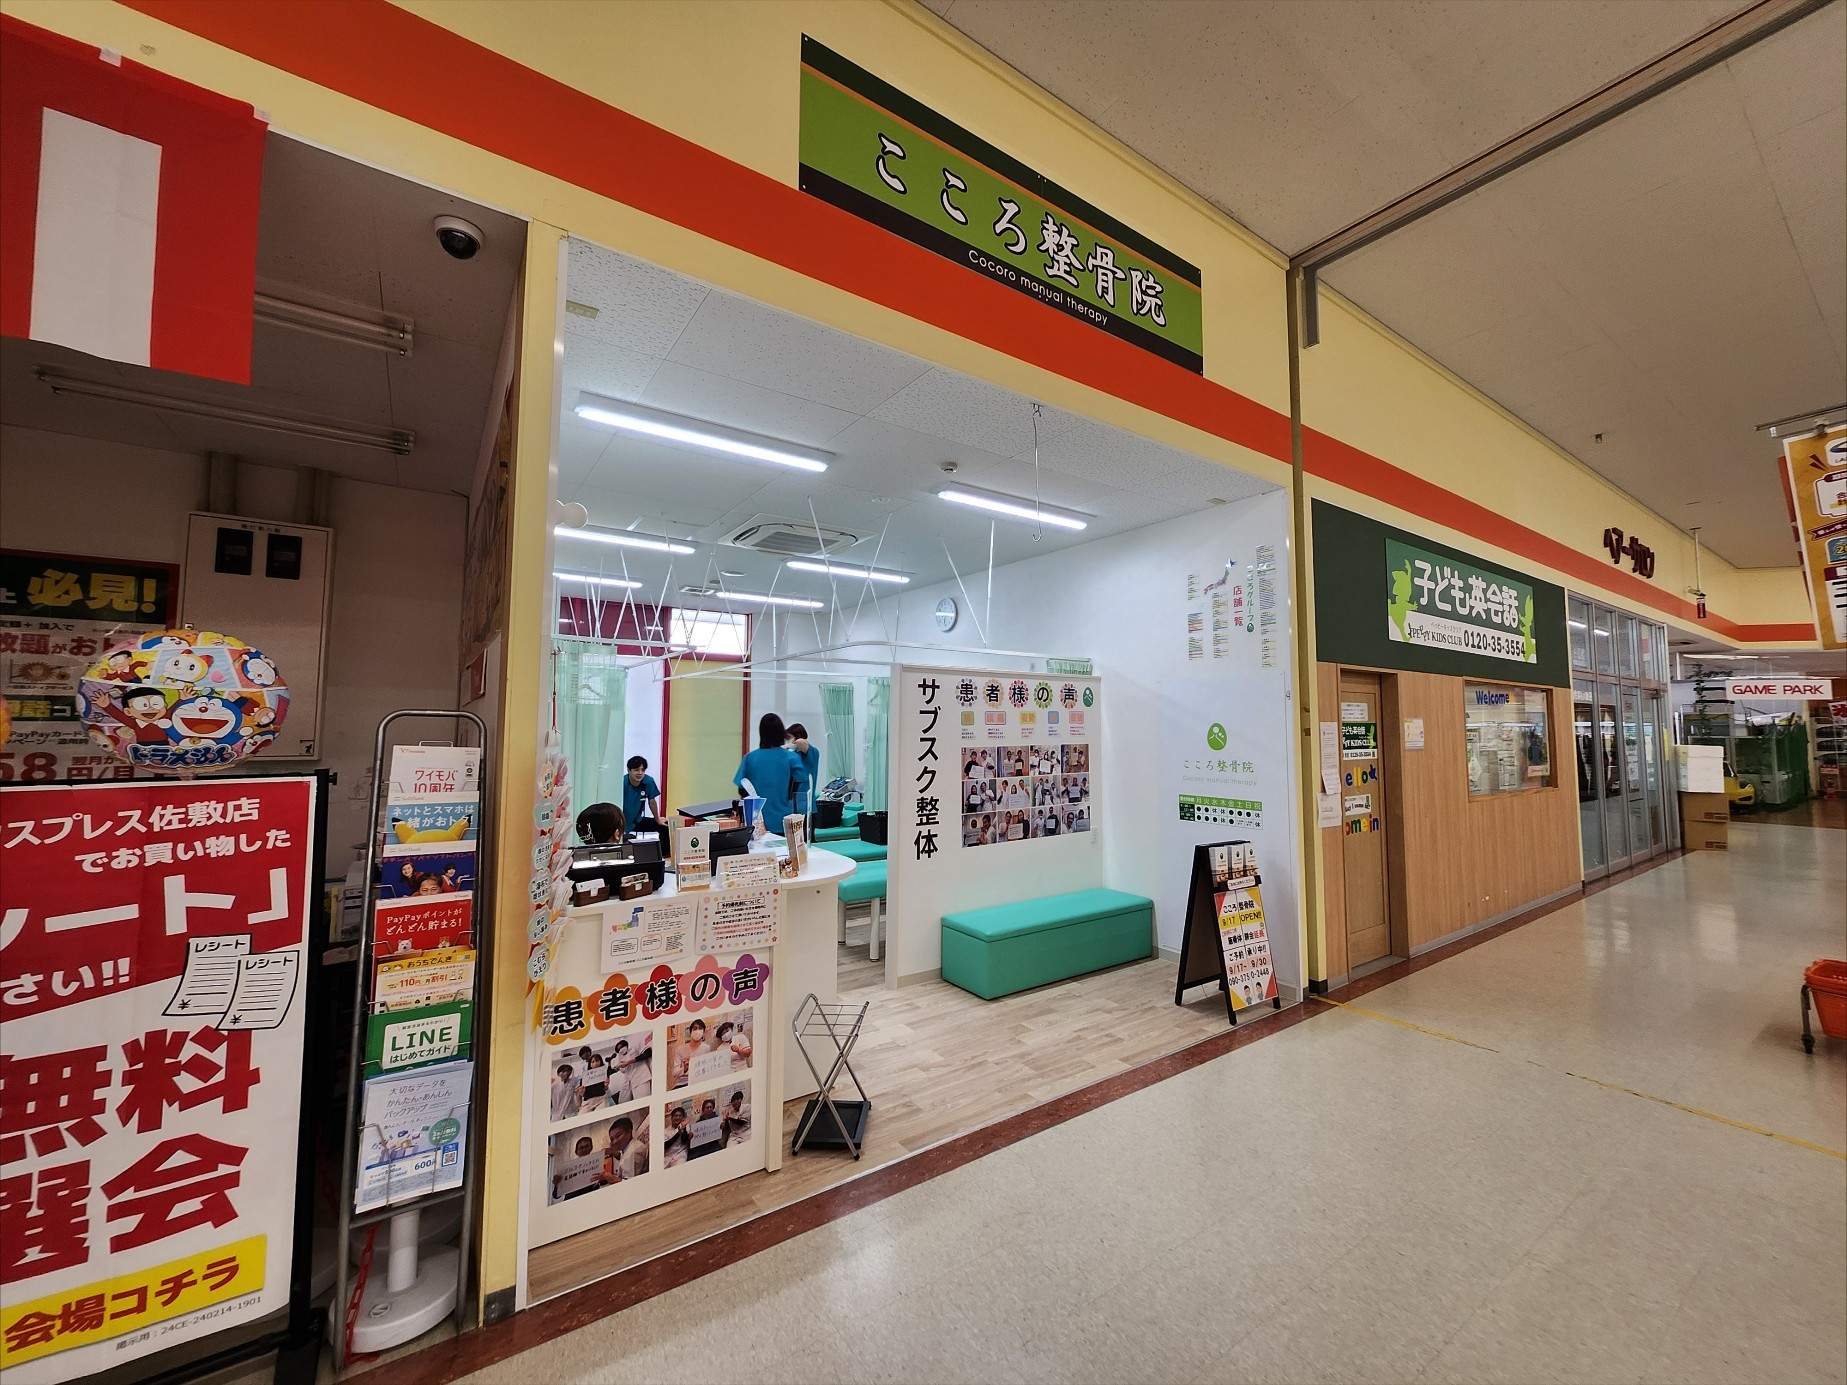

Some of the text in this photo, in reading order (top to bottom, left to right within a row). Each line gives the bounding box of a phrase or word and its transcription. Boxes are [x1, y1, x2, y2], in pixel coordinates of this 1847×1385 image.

[875, 131, 1167, 326] こころ整骨院
[968, 249, 1108, 327] Cocoro manual therapy
[27, 568, 157, 613] 必見!
[1414, 559, 1518, 628] 子ども英会話
[1431, 632, 1446, 643] KIDS
[1447, 634, 1462, 645] CLUB
[959, 682, 1076, 704] 患者様の声
[1475, 690, 1509, 704] Welcome
[1732, 684, 1823, 695] GAME PARK
[415, 770, 458, 781] ワイモバ
[913, 678, 941, 860] サブスク整体
[1183, 760, 1254, 774] こころ整骨院
[4, 797, 260, 849] スプレス佐敷店
[392, 804, 475, 817] ネットとスマホは
[75, 828, 292, 873] でお買い物した
[386, 918, 462, 935] どんどん貯まる!
[387, 908, 462, 924] PayPayポイントが
[194, 939, 246, 952] レシート
[244, 956, 293, 970] レシート
[1, 957, 130, 1005] さい!!
[551, 967, 759, 1036] 患者様の声
[391, 1025, 453, 1051] LINE
[0, 1025, 261, 1165] 無料
[5, 1256, 240, 1351] 会場コチラ
